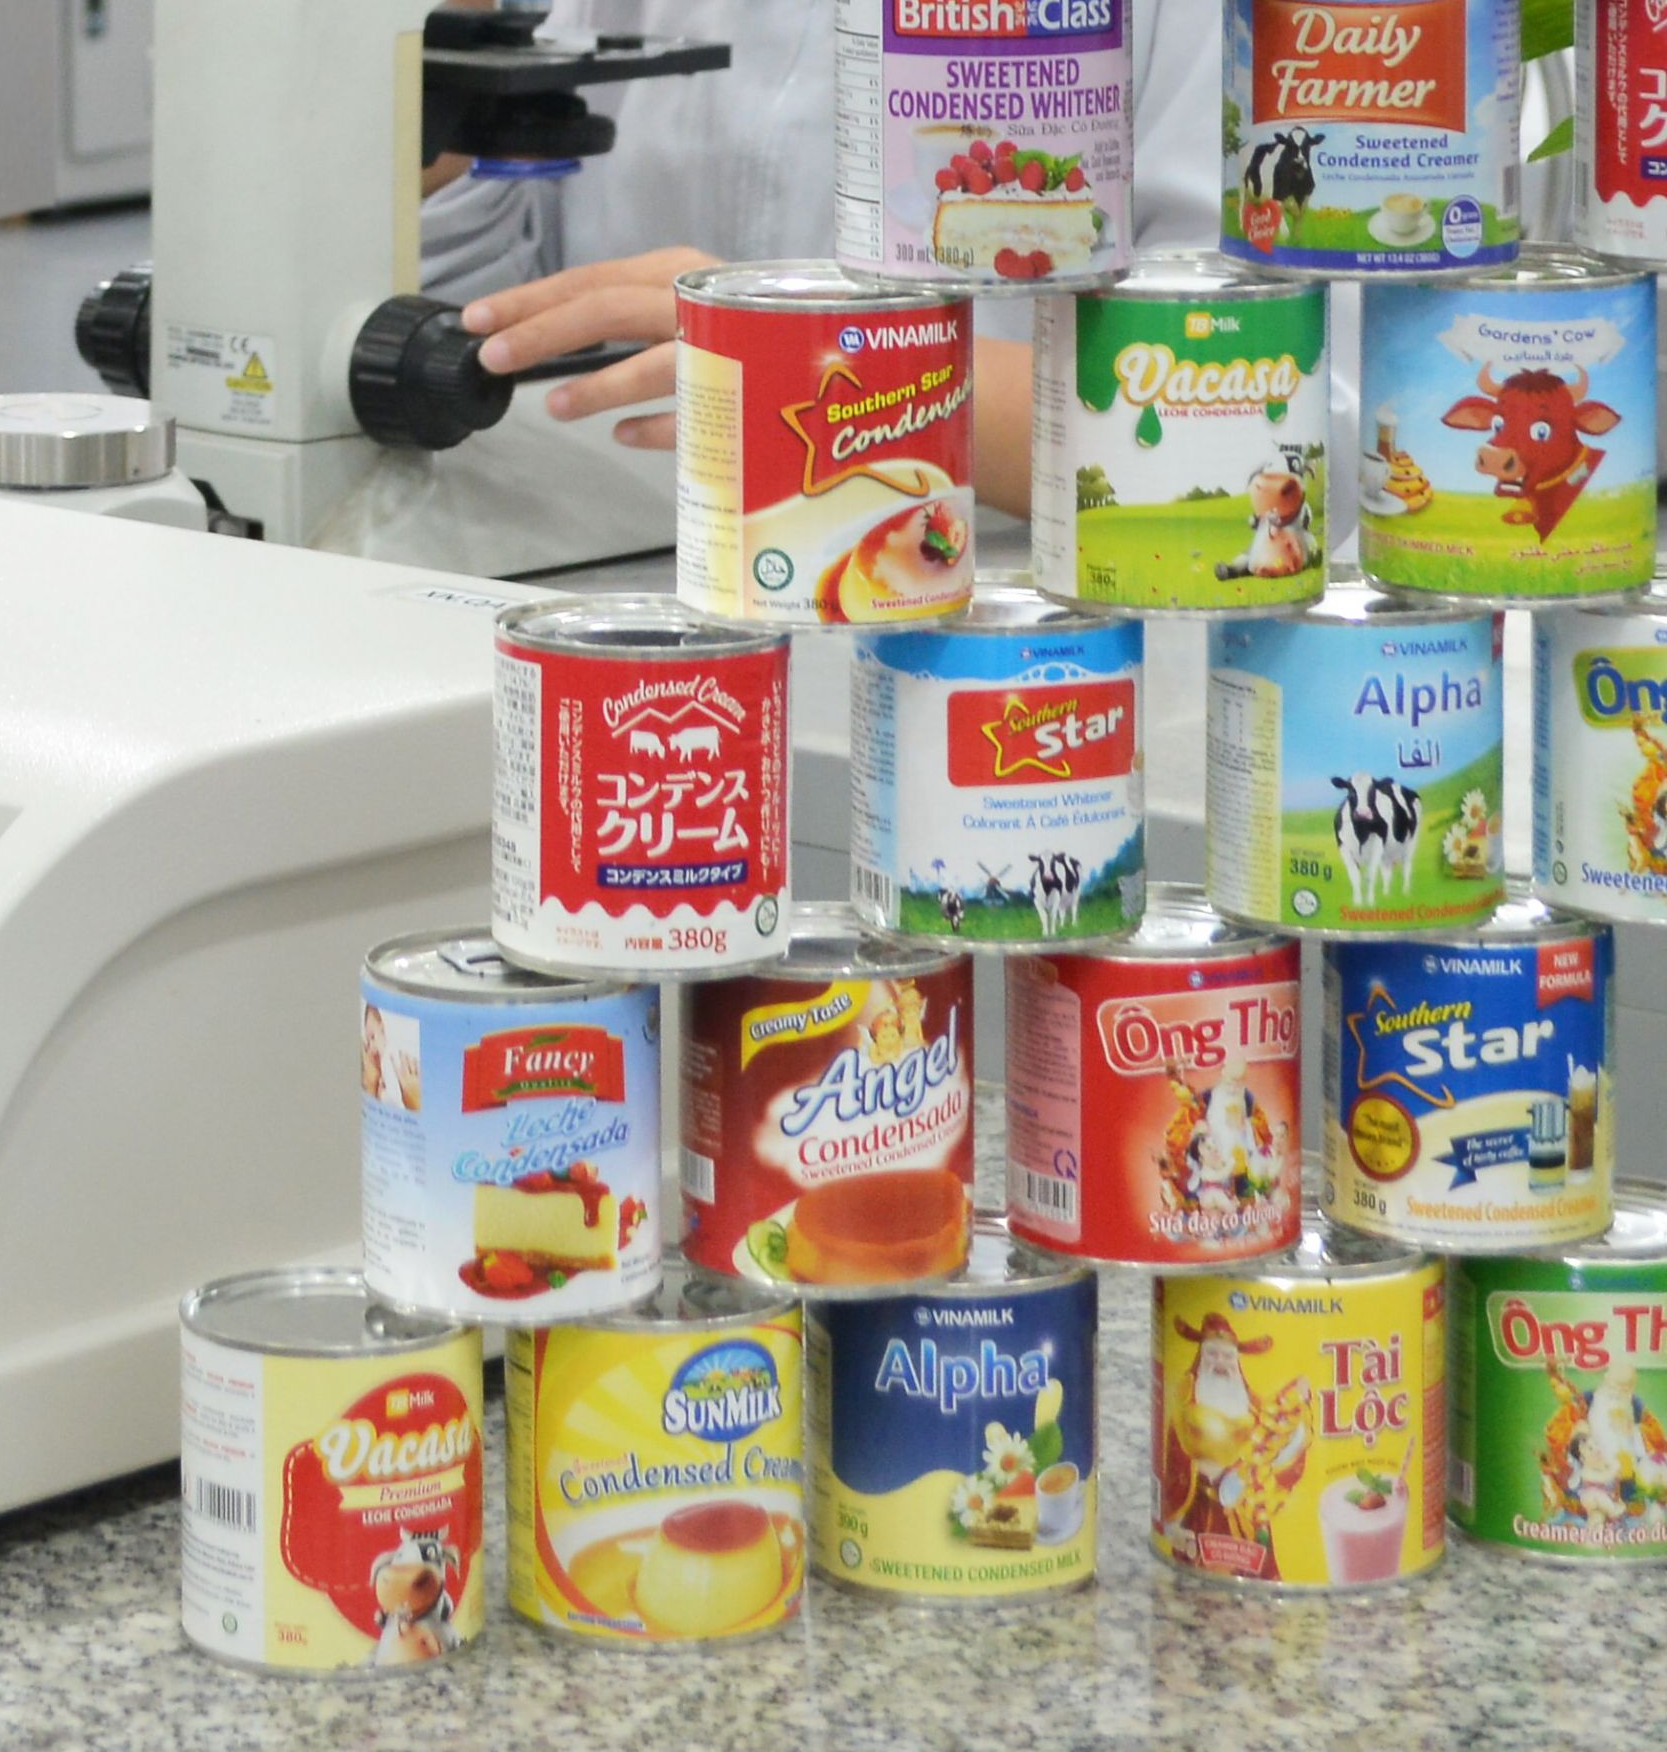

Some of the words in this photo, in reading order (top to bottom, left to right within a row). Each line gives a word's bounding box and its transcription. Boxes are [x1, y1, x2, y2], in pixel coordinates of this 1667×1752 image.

[1291, 7, 1422, 68] Daily
[946, 58, 1080, 89] SWEETENED
[1271, 58, 1437, 115] Farmer
[888, 89, 1025, 120] CONDENSED
[1032, 85, 1121, 119] WHITENER
[1355, 134, 1448, 149] Sweetened
[1317, 151, 1411, 168] Condensed
[1417, 152, 1480, 168] Creamer
[865, 320, 958, 351] VINAMILK
[1210, 316, 1241, 333] Milk
[1562, 327, 1596, 344] Cow
[1118, 347, 1298, 403] Vacasa
[826, 381, 917, 424] Southern
[920, 363, 954, 393] Star
[1158, 408, 1189, 419] LECHE
[1192, 406, 1264, 418] CONDENSADA
[872, 597, 923, 609] Sweetened
[1397, 638, 1468, 657] VINAMILK
[602, 675, 700, 729] Condensed
[697, 676, 747, 723] Cream
[1353, 670, 1483, 728] Alpha
[1007, 697, 1079, 736] Southern
[1034, 706, 1124, 760] Star
[597, 769, 750, 810] コンデンス
[983, 795, 1057, 810] Sweetened
[1062, 790, 1112, 807] Whitener
[596, 807, 750, 859] クリーム
[963, 814, 1021, 829] Colorant
[606, 862, 744, 885] コンデンスミルクタイプ
[1289, 858, 1319, 876] 380
[1340, 905, 1415, 922] Sweetened
[668, 927, 727, 953] 380g
[1440, 958, 1522, 975] VINAMILK
[1553, 952, 1579, 967] NEW
[1539, 970, 1592, 989] FORMULA
[750, 1009, 808, 1041] Creamy
[809, 992, 853, 1026] Taste
[1374, 1001, 1472, 1035] Southern
[1115, 1004, 1227, 1068] Ông
[1229, 998, 1294, 1053] Thọ
[1402, 1019, 1555, 1076] Star
[503, 1046, 595, 1078] Fancy
[780, 1003, 959, 1137] Angel
[797, 1089, 963, 1168] Condensada
[452, 1116, 630, 1185] Condensada
[800, 1154, 874, 1181] Sweetened
[1353, 1190, 1376, 1210] 380
[1406, 1196, 1483, 1221] Sweetened
[1488, 1199, 1556, 1221] Condensed
[932, 1308, 1014, 1327] VINAMILK
[1250, 1295, 1344, 1314] VINAMILK
[1500, 1299, 1610, 1370] Ông
[875, 1338, 1049, 1415] Alpha
[1322, 1333, 1402, 1389] Tài
[409, 1390, 436, 1408] Milk
[1319, 1389, 1409, 1448] Lộc
[560, 1443, 734, 1506] Condensed
[379, 1481, 443, 1503] Premium
[362, 1510, 392, 1525] LECHE
[394, 1498, 453, 1522] CONDENSADA
[1513, 1513, 1586, 1544] Creamer
[872, 1561, 963, 1582] SWEETENED
[968, 1560, 1053, 1580] CONDENSED
[1057, 1552, 1082, 1571] MILK
